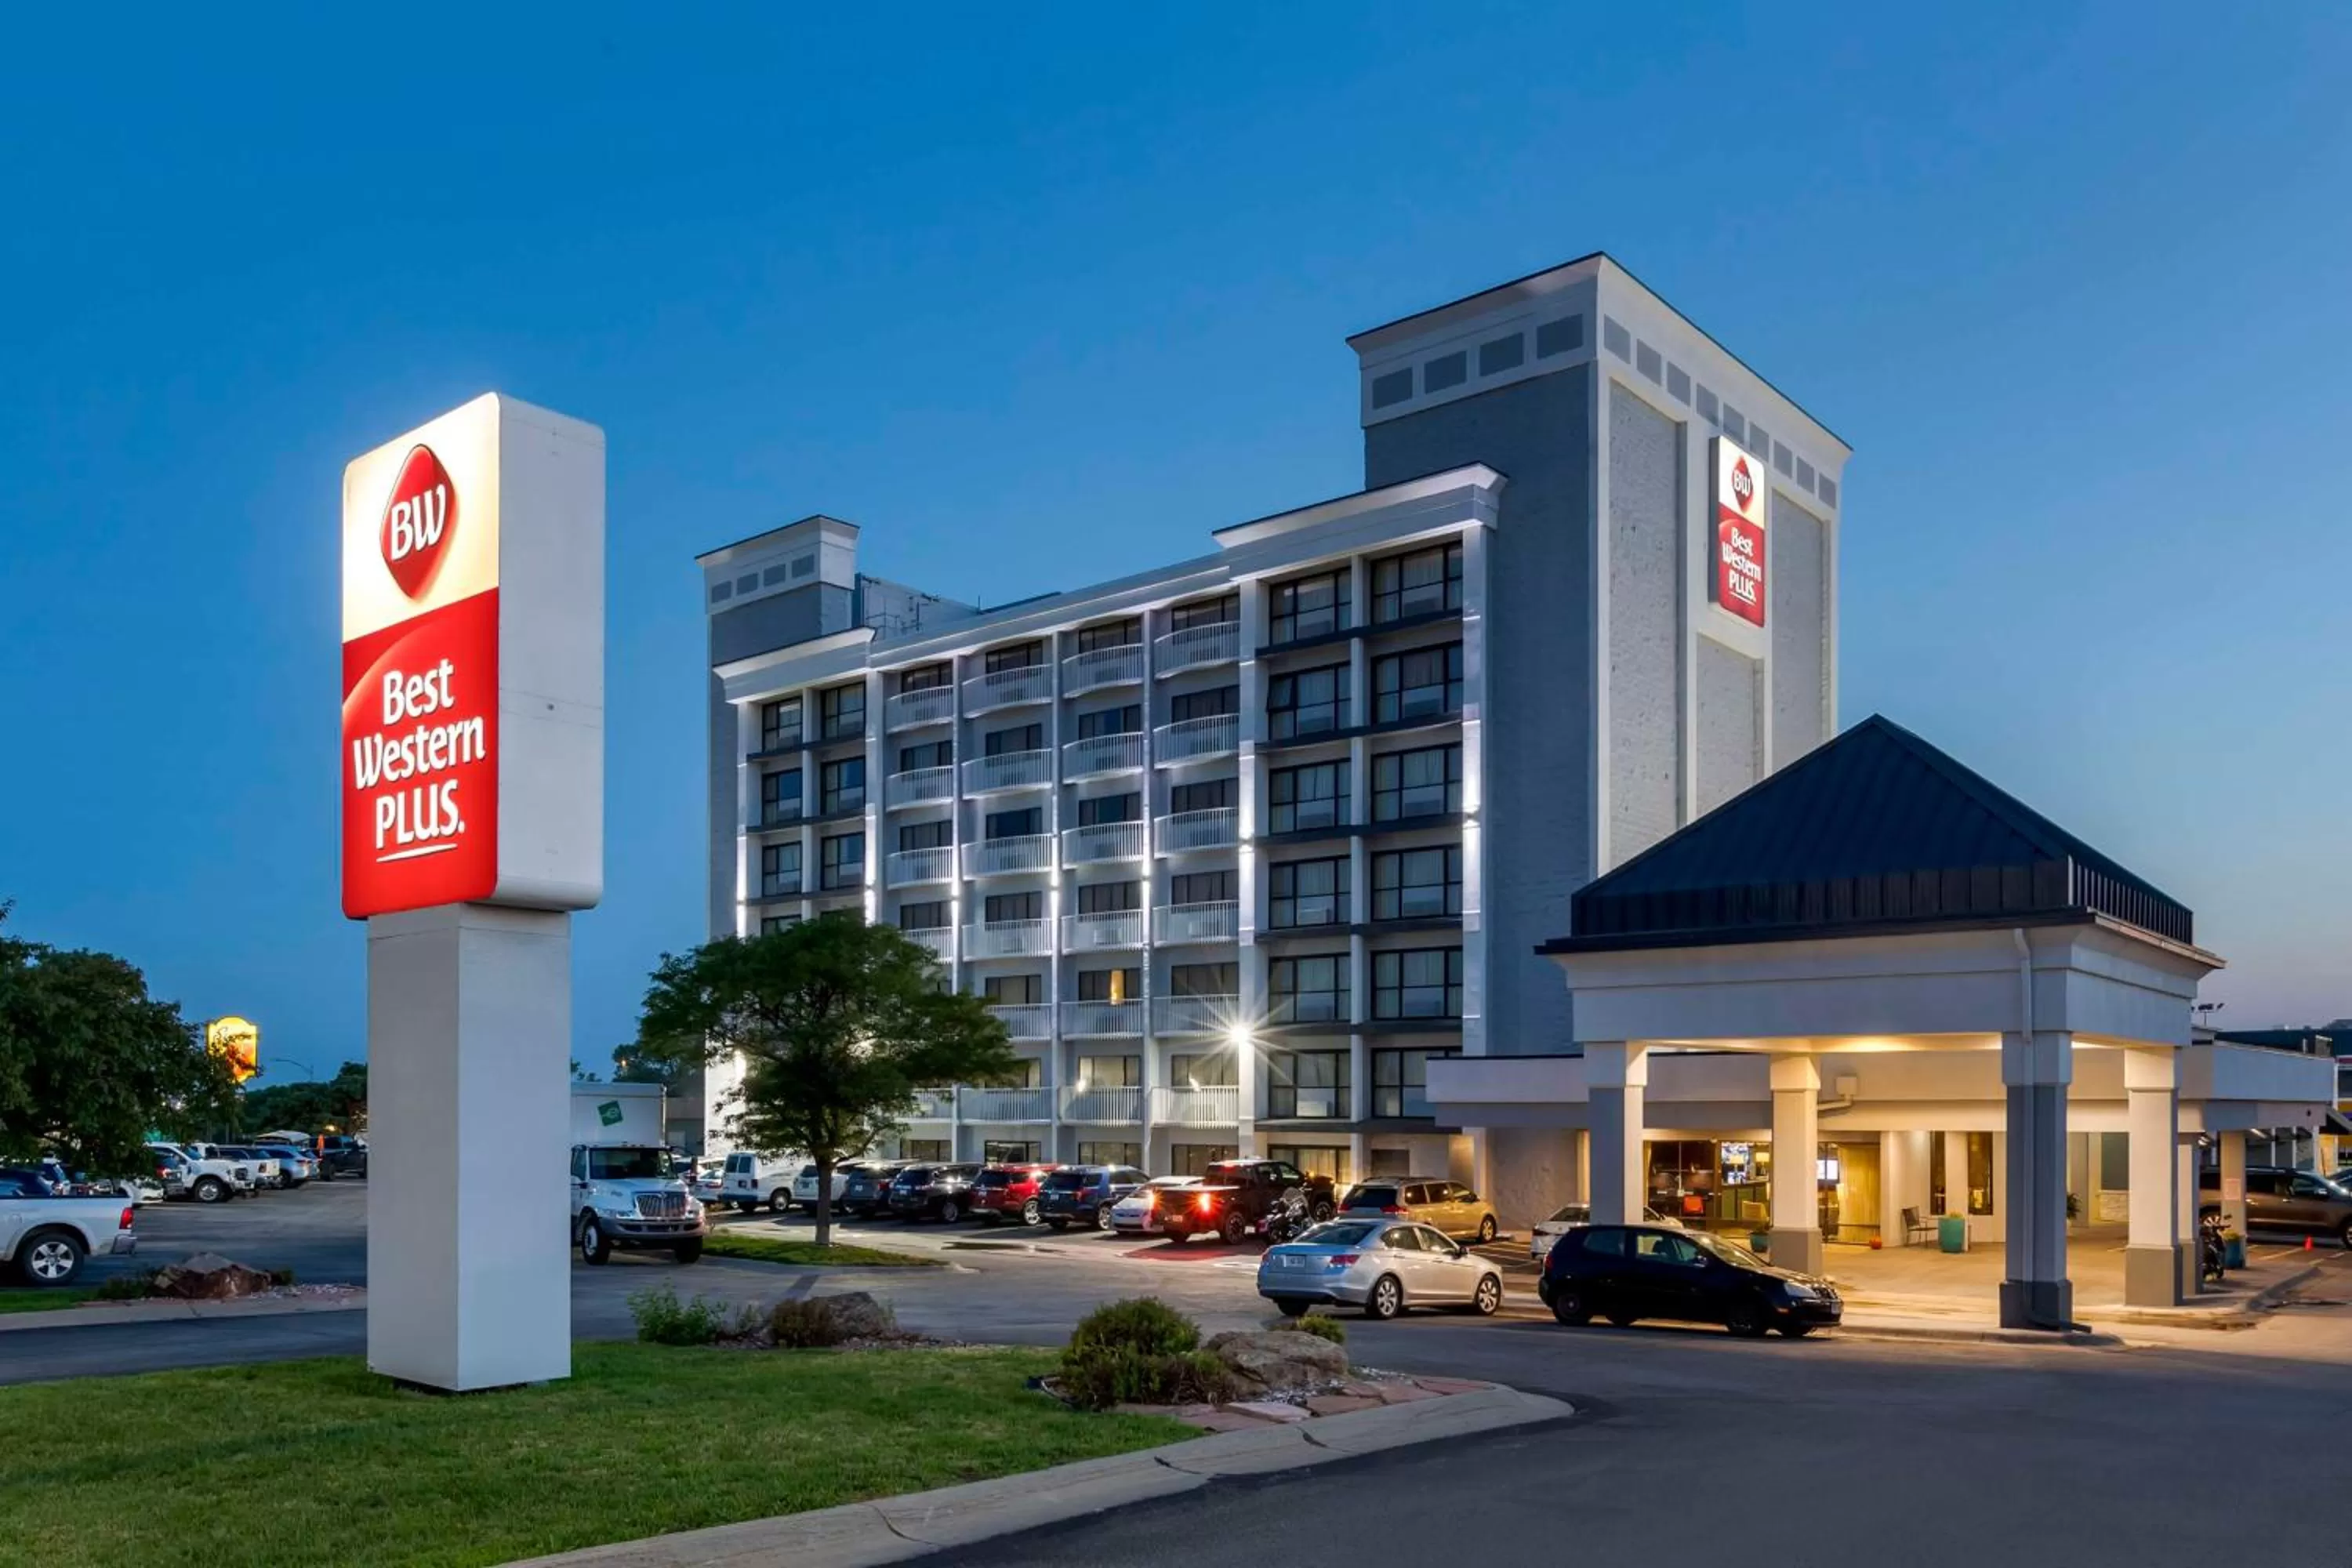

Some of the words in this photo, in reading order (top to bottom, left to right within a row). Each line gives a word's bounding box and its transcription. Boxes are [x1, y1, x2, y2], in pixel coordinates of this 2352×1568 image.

[1733, 470, 1751, 497] BW
[390, 484, 445, 560] BW
[1731, 526, 1754, 557] Best
[1722, 541, 1761, 581] Western
[382, 659, 455, 725] Best
[353, 715, 485, 791] Western
